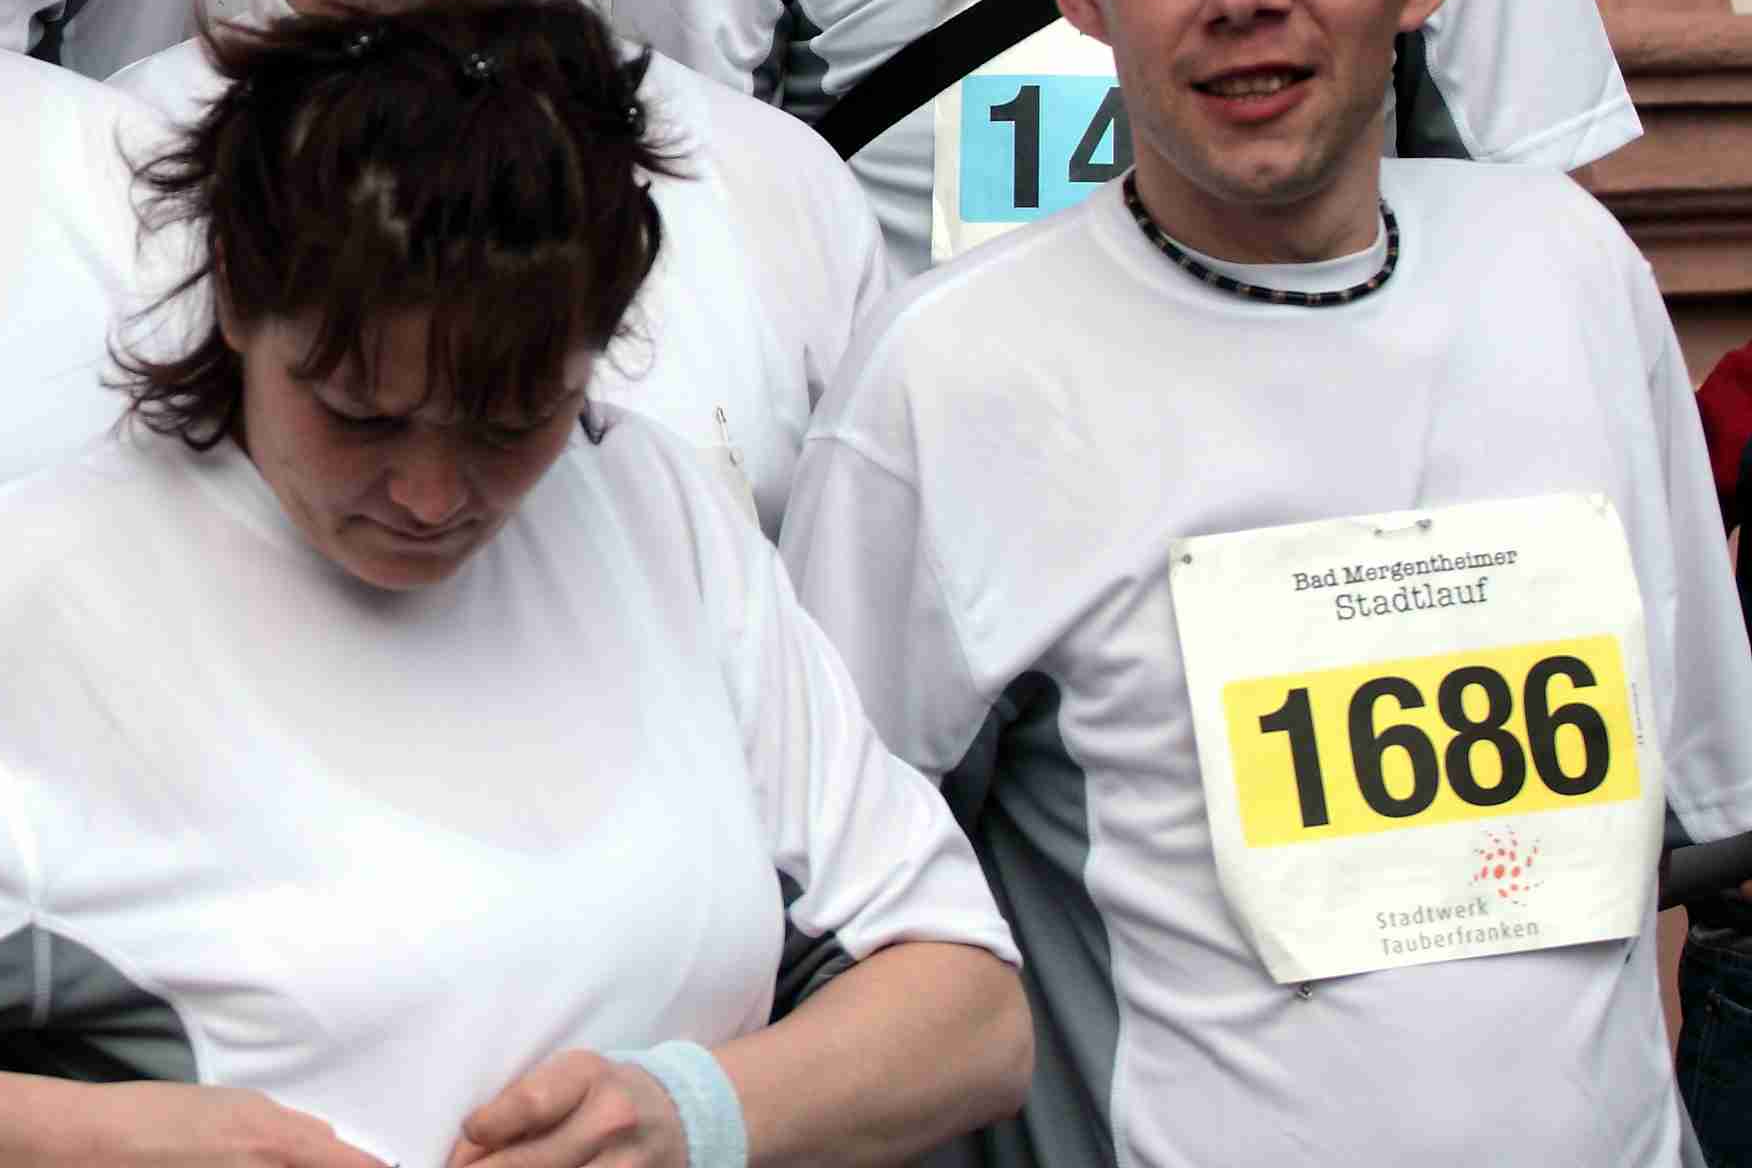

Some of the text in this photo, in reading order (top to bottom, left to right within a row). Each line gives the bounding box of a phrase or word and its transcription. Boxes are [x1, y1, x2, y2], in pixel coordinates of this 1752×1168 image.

[1293, 549, 1518, 592] Bad Mergentheimer
[1335, 576, 1489, 621] Stadtlauf
[1258, 655, 1611, 828] 1686
[1376, 897, 1489, 930] Stadtwerk
[1380, 921, 1540, 956] Tauberfranken
